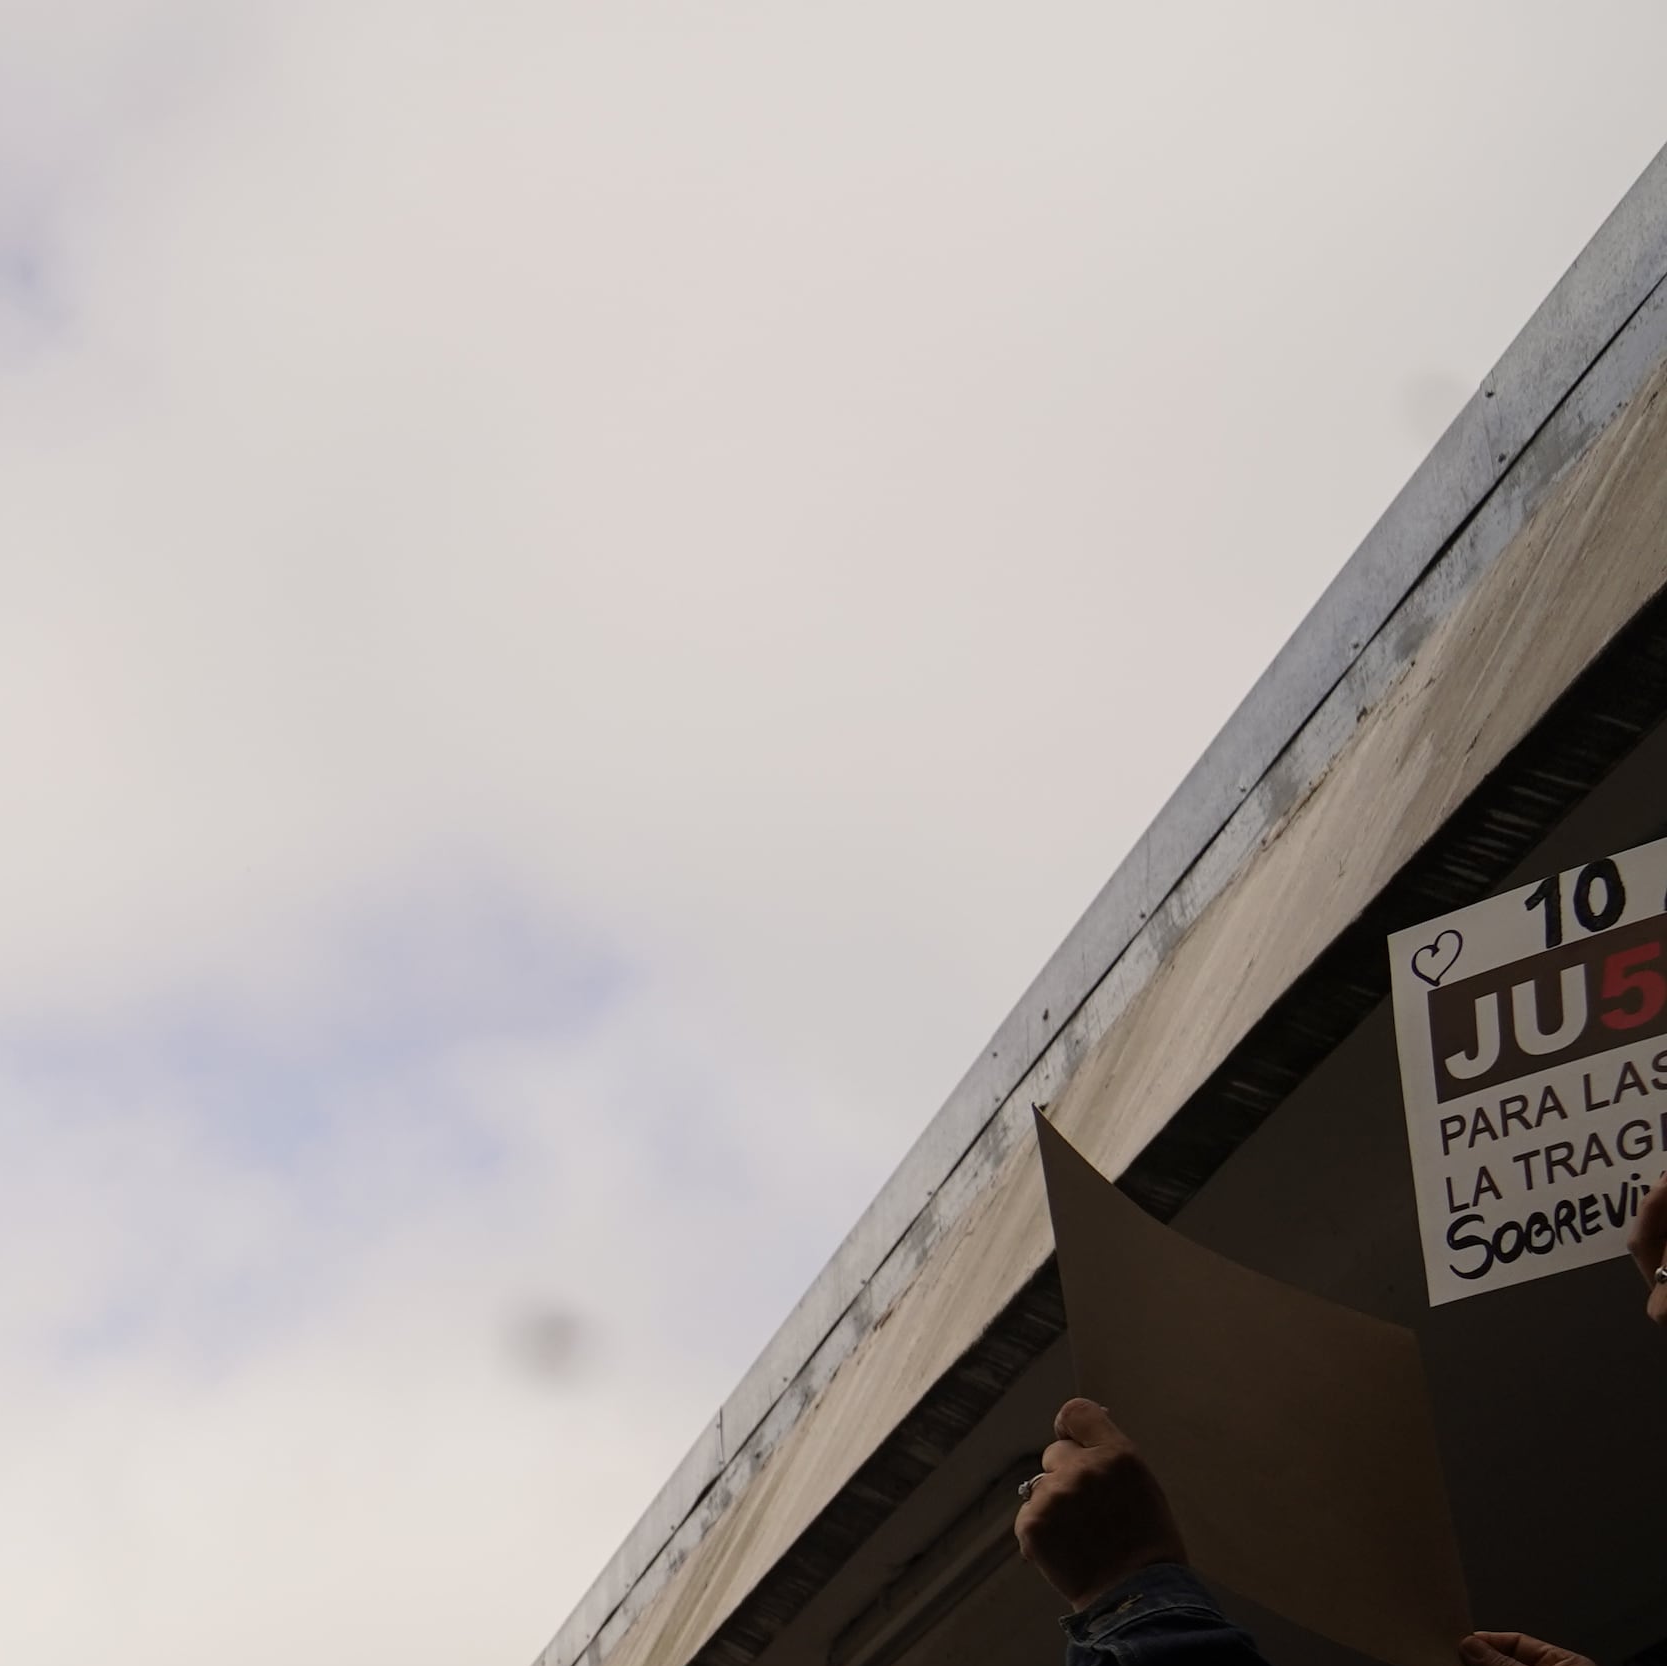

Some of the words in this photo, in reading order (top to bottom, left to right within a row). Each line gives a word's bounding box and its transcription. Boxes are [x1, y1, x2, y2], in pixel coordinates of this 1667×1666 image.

[1524, 858, 1626, 948] 10
[1440, 1085, 1568, 1156] PARA
[1445, 1166, 1503, 1214] LA
[1513, 1113, 1667, 1191] TRAG
